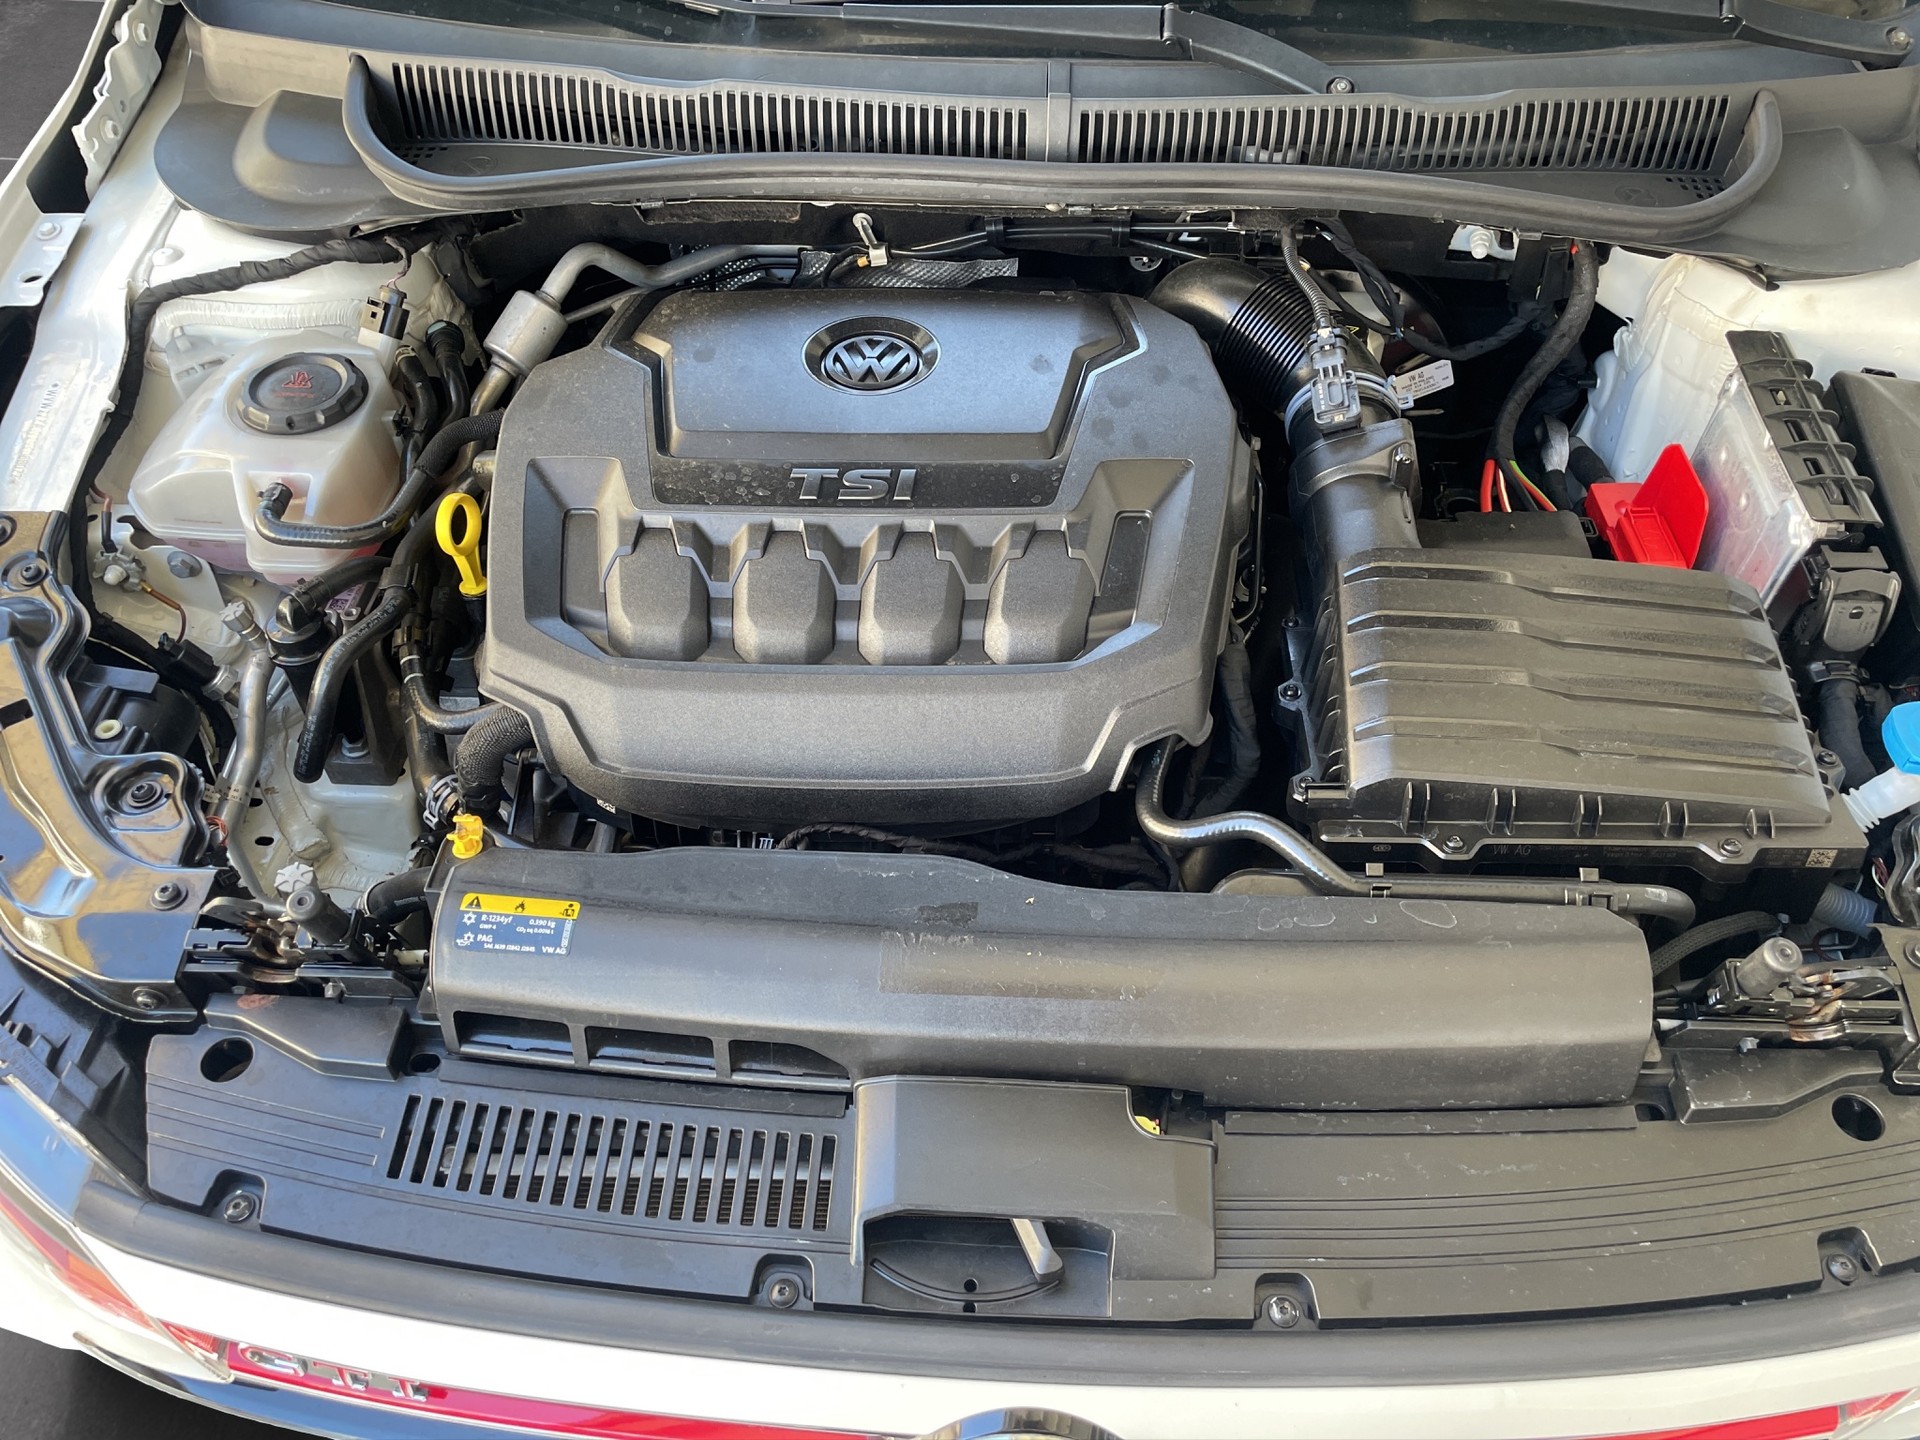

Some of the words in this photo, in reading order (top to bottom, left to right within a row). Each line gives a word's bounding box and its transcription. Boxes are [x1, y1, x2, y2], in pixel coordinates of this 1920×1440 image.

[789, 468, 918, 501] TSI
[1492, 844, 1509, 855] VW
[1514, 845, 1532, 856] AG
[481, 914, 513, 925] R-1234yf
[547, 919, 556, 929] kg
[476, 934, 493, 942] PAG
[555, 947, 567, 955] AG
[238, 1342, 428, 1402] GTI
